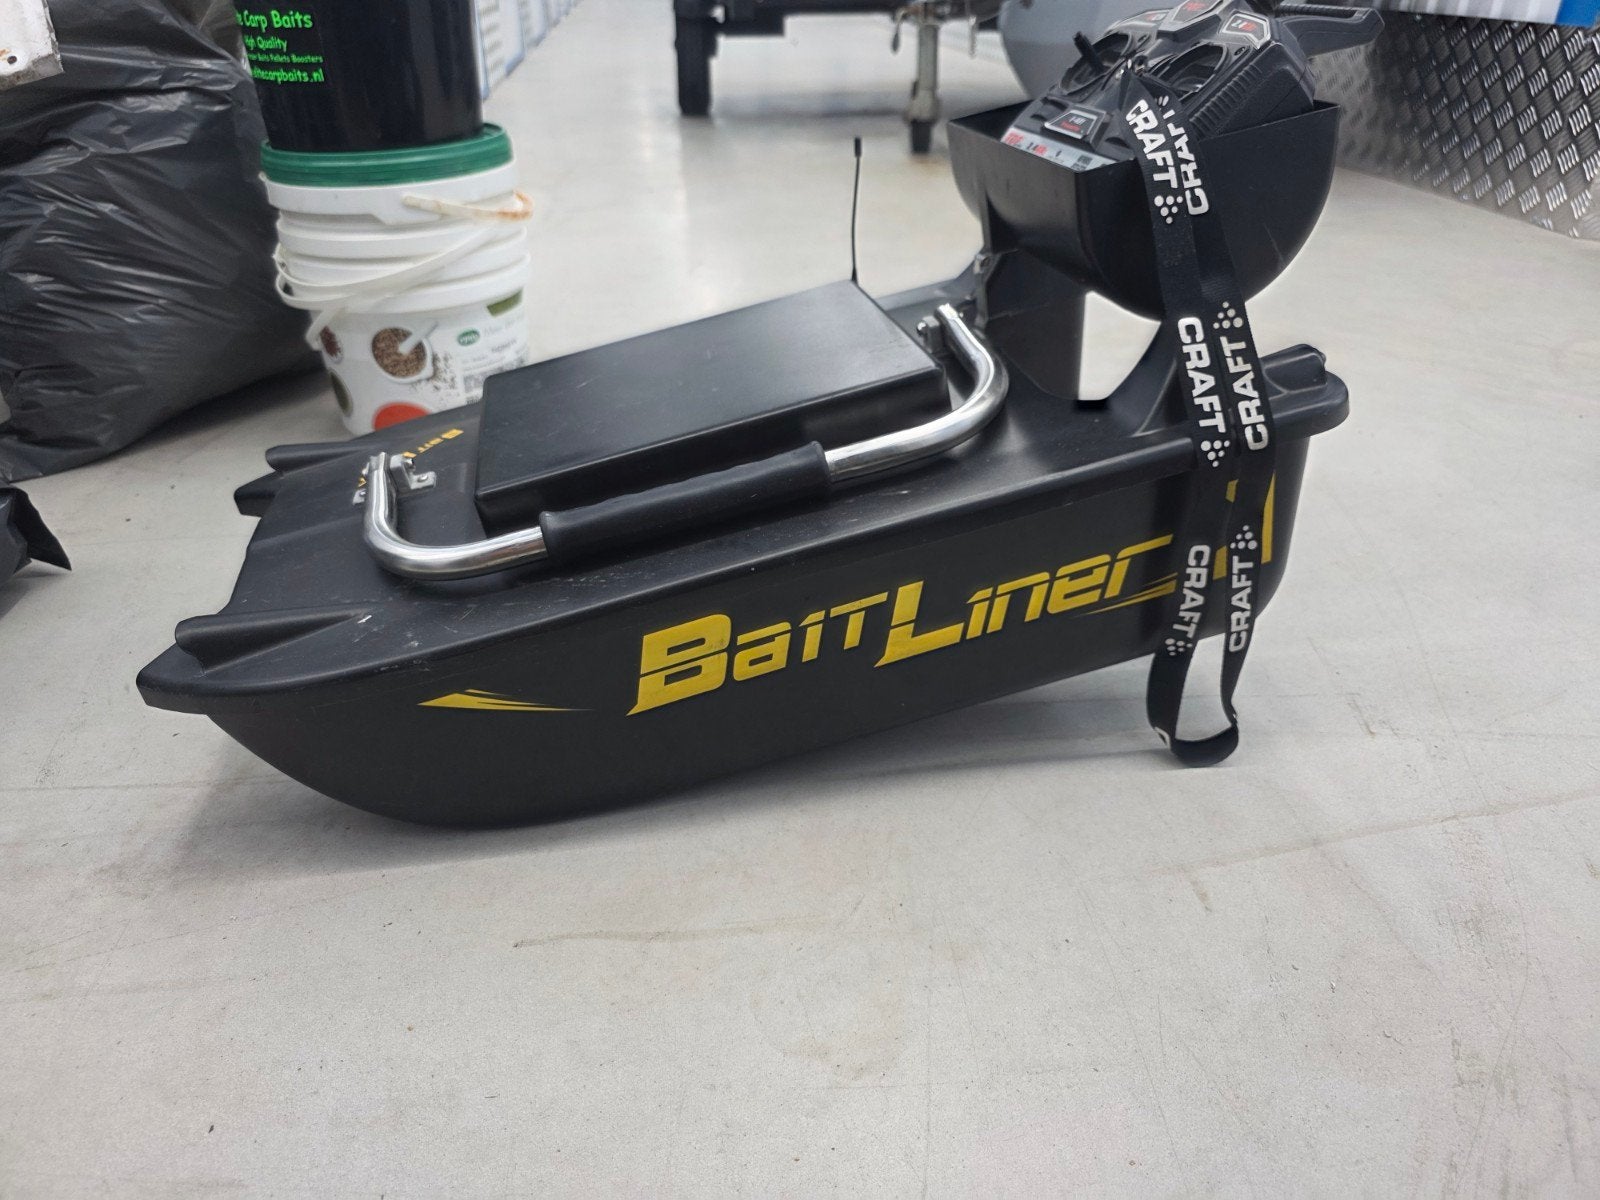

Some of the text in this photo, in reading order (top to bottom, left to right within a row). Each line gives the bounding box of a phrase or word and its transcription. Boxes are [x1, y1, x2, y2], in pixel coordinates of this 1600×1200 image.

[243, 9, 268, 33] Carp
[271, 9, 314, 29] Baits
[256, 35, 288, 52] Quality
[1125, 99, 1178, 189] CRAFT
[1177, 316, 1226, 433] CRAFT
[1220, 336, 1269, 450] CRAFT
[1173, 544, 1211, 638] CRAFT
[1229, 555, 1254, 652] CRAFT
